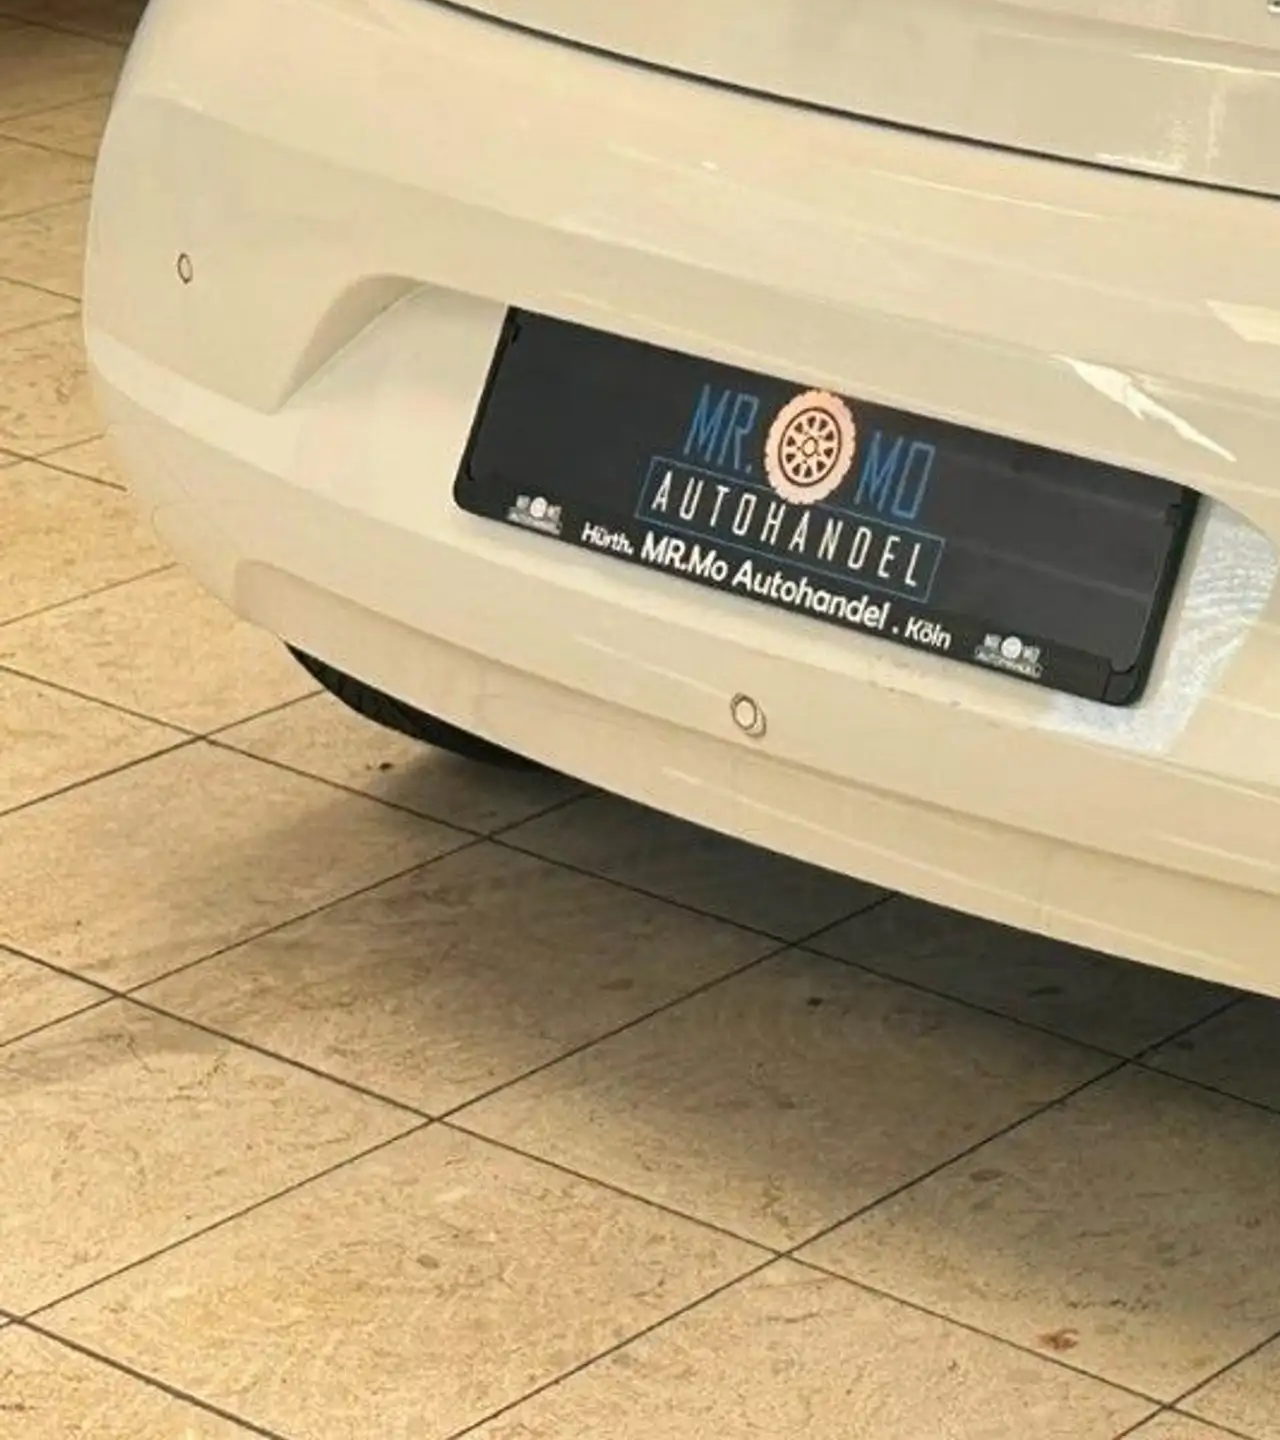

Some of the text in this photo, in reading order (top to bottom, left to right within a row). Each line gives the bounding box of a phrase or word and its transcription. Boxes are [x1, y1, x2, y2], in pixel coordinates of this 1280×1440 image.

[650, 470, 923, 588] AUTOHANDEL
[854, 431, 936, 520] MO
[580, 521, 634, 555] Hürth.
[641, 530, 728, 582] MR.Mo
[732, 560, 890, 631] Autohandel
[904, 616, 952, 650] Köln
